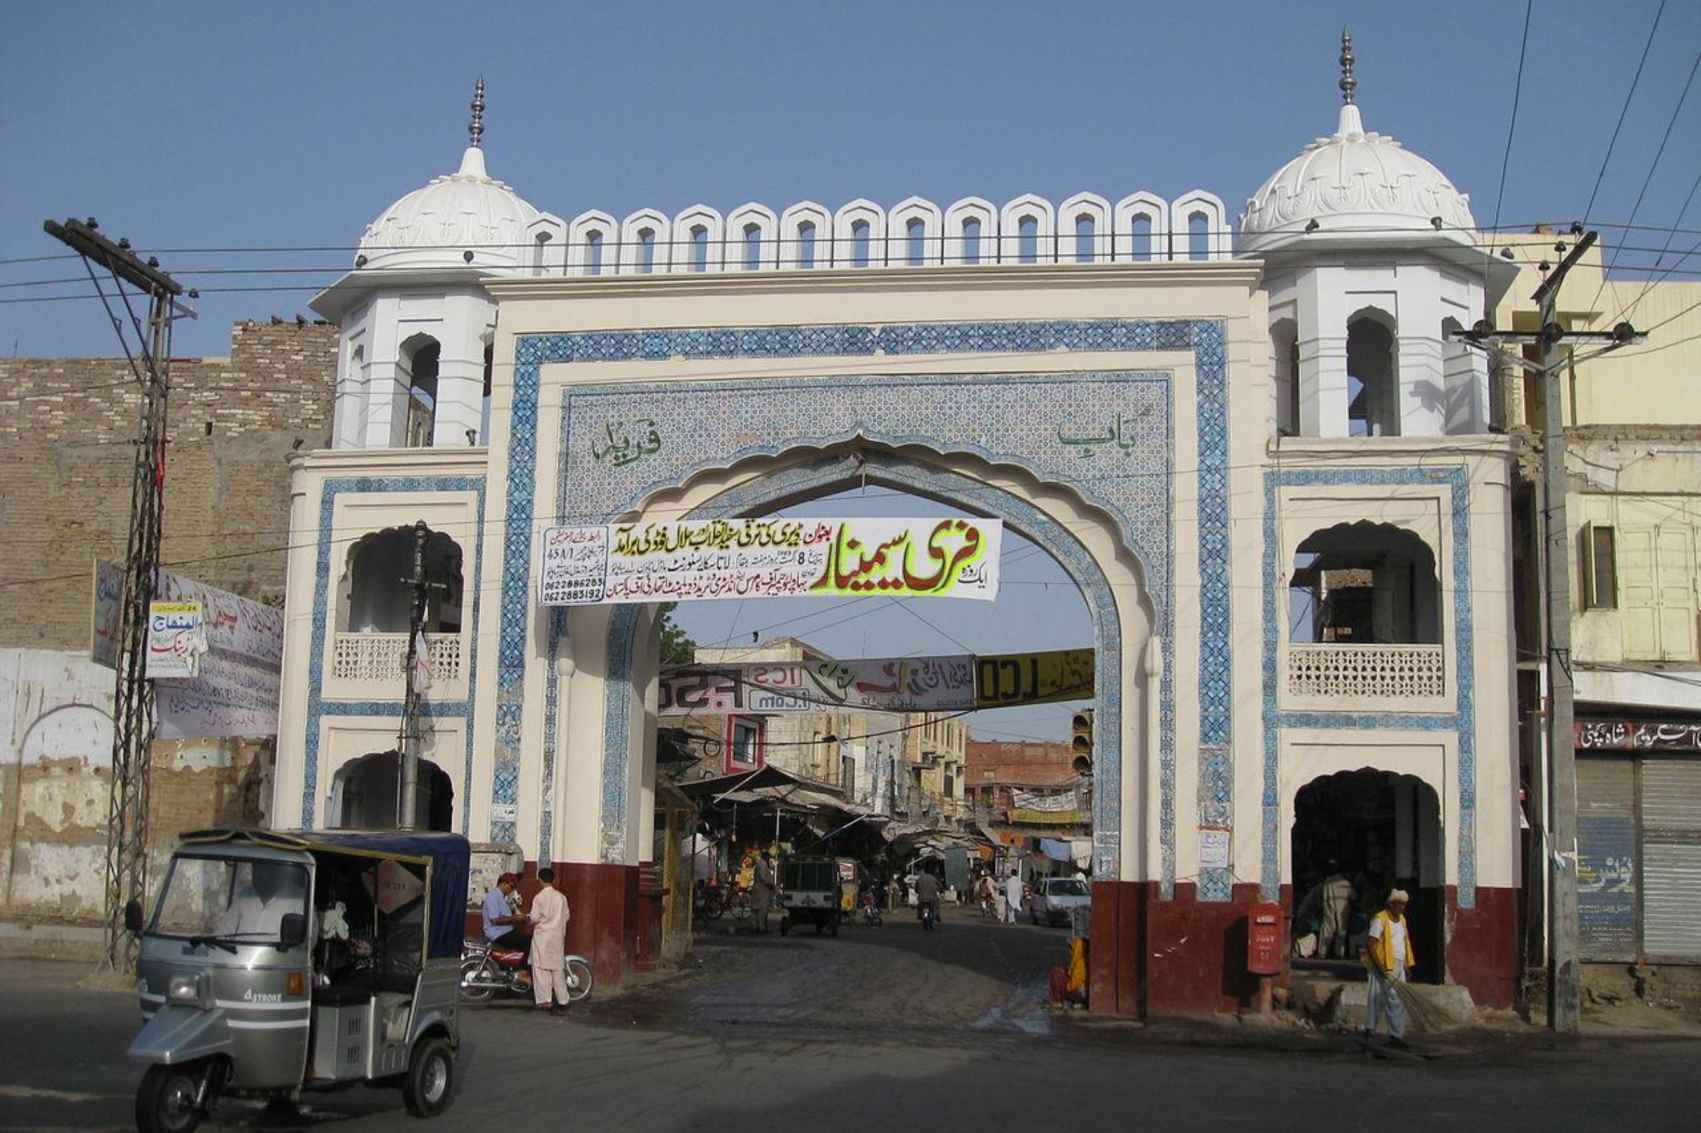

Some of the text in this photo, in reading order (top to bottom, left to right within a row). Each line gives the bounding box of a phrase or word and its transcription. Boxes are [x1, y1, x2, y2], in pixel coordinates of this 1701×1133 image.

[611, 525, 640, 556] برآمد
[637, 523, 656, 555] کی
[737, 518, 766, 546] ترقی
[798, 551, 805, 565] 8
[810, 519, 980, 593] فری سیمینار
[1605, 720, 1625, 744] شاہ
